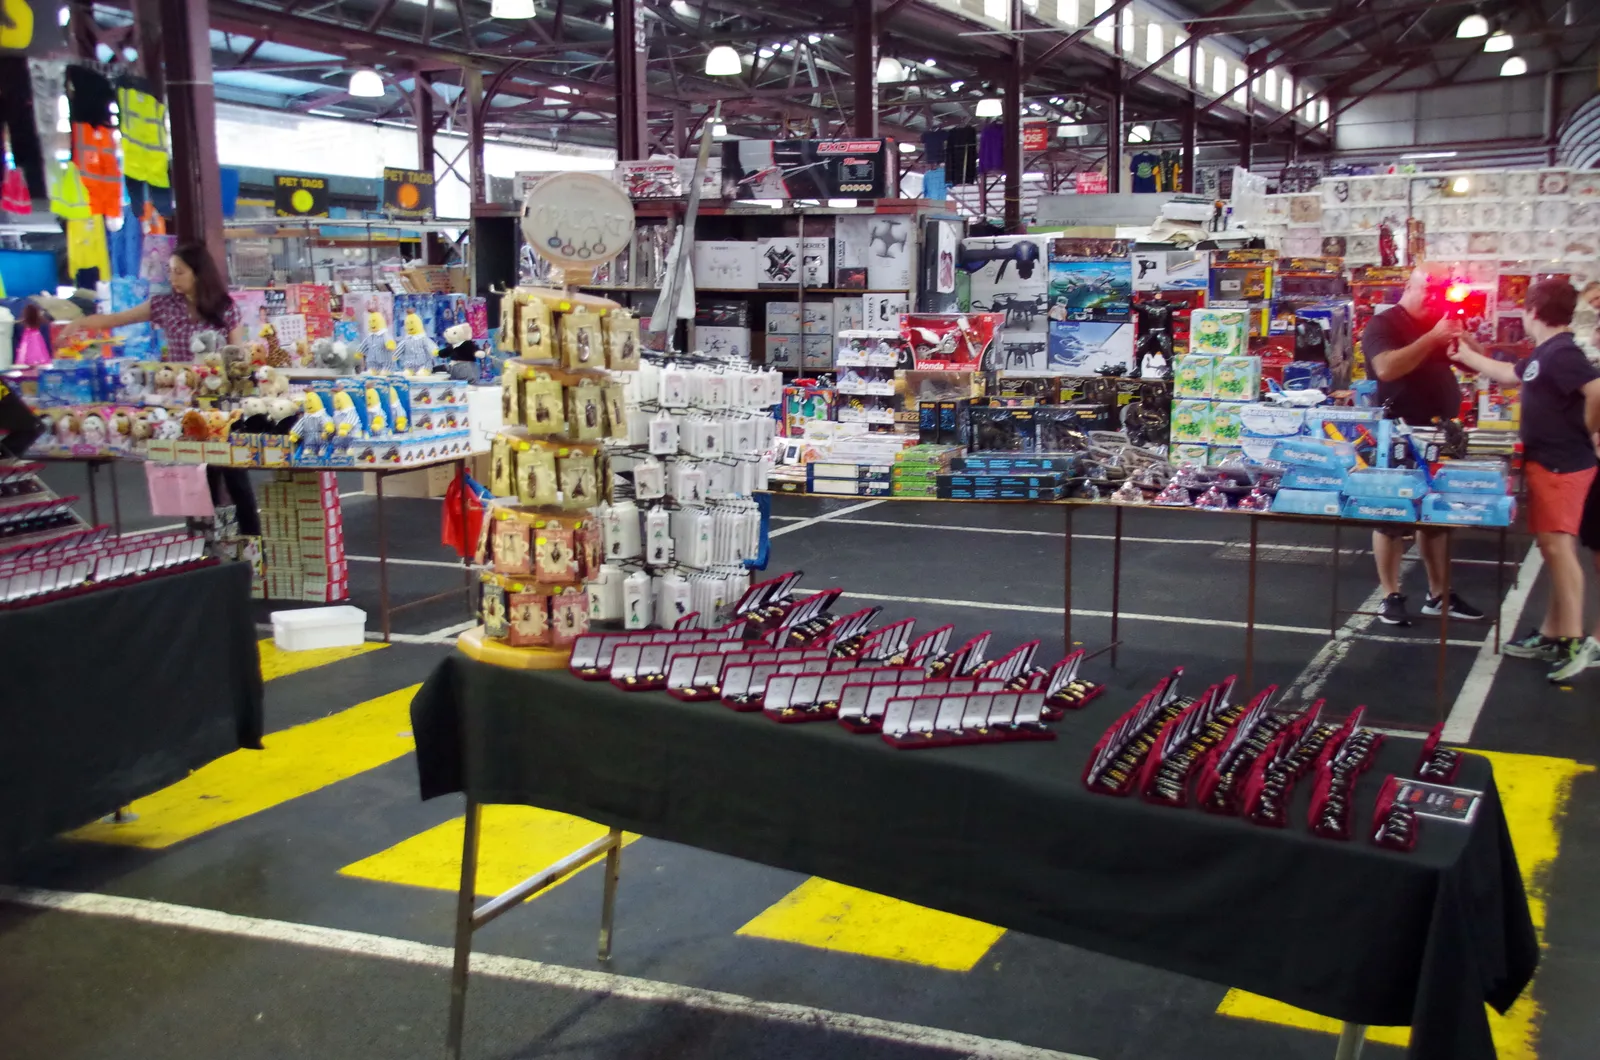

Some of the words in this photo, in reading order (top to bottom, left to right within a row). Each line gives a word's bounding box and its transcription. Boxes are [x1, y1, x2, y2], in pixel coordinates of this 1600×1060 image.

[384, 169, 405, 182] PET
[407, 171, 433, 184] TAGS
[279, 176, 299, 187] PET
[300, 178, 324, 188] TAGS
[917, 361, 945, 370] Honda
[900, 412, 919, 421] F-22
